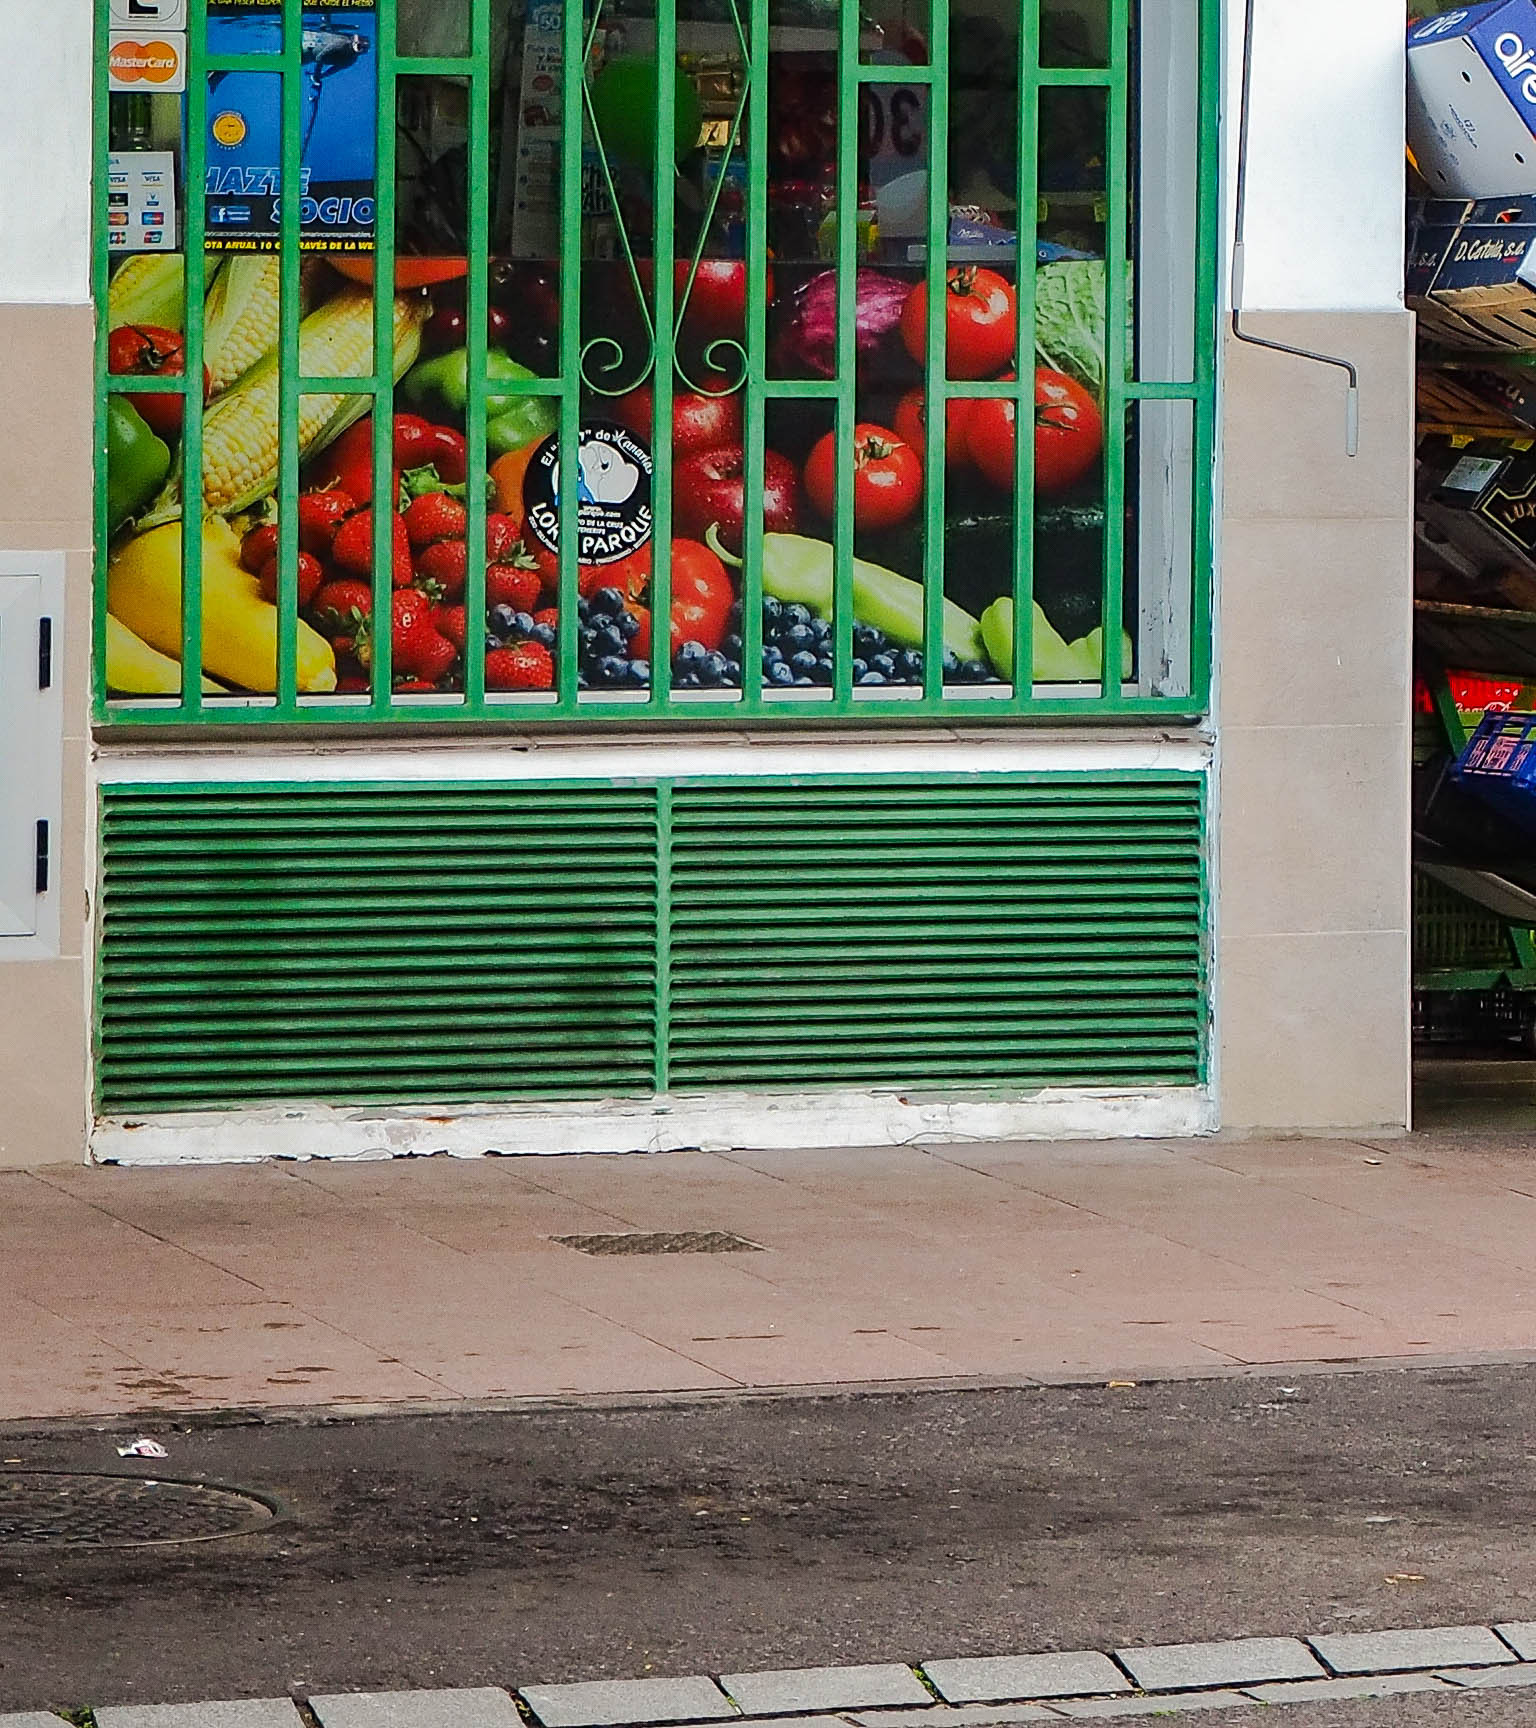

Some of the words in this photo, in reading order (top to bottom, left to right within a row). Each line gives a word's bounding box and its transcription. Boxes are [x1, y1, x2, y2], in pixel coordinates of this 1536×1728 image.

[110, 56, 175, 69] MasterCard
[225, 242, 257, 250] ANUAL
[531, 502, 559, 542] LOR
[582, 505, 652, 555] PARQUE
